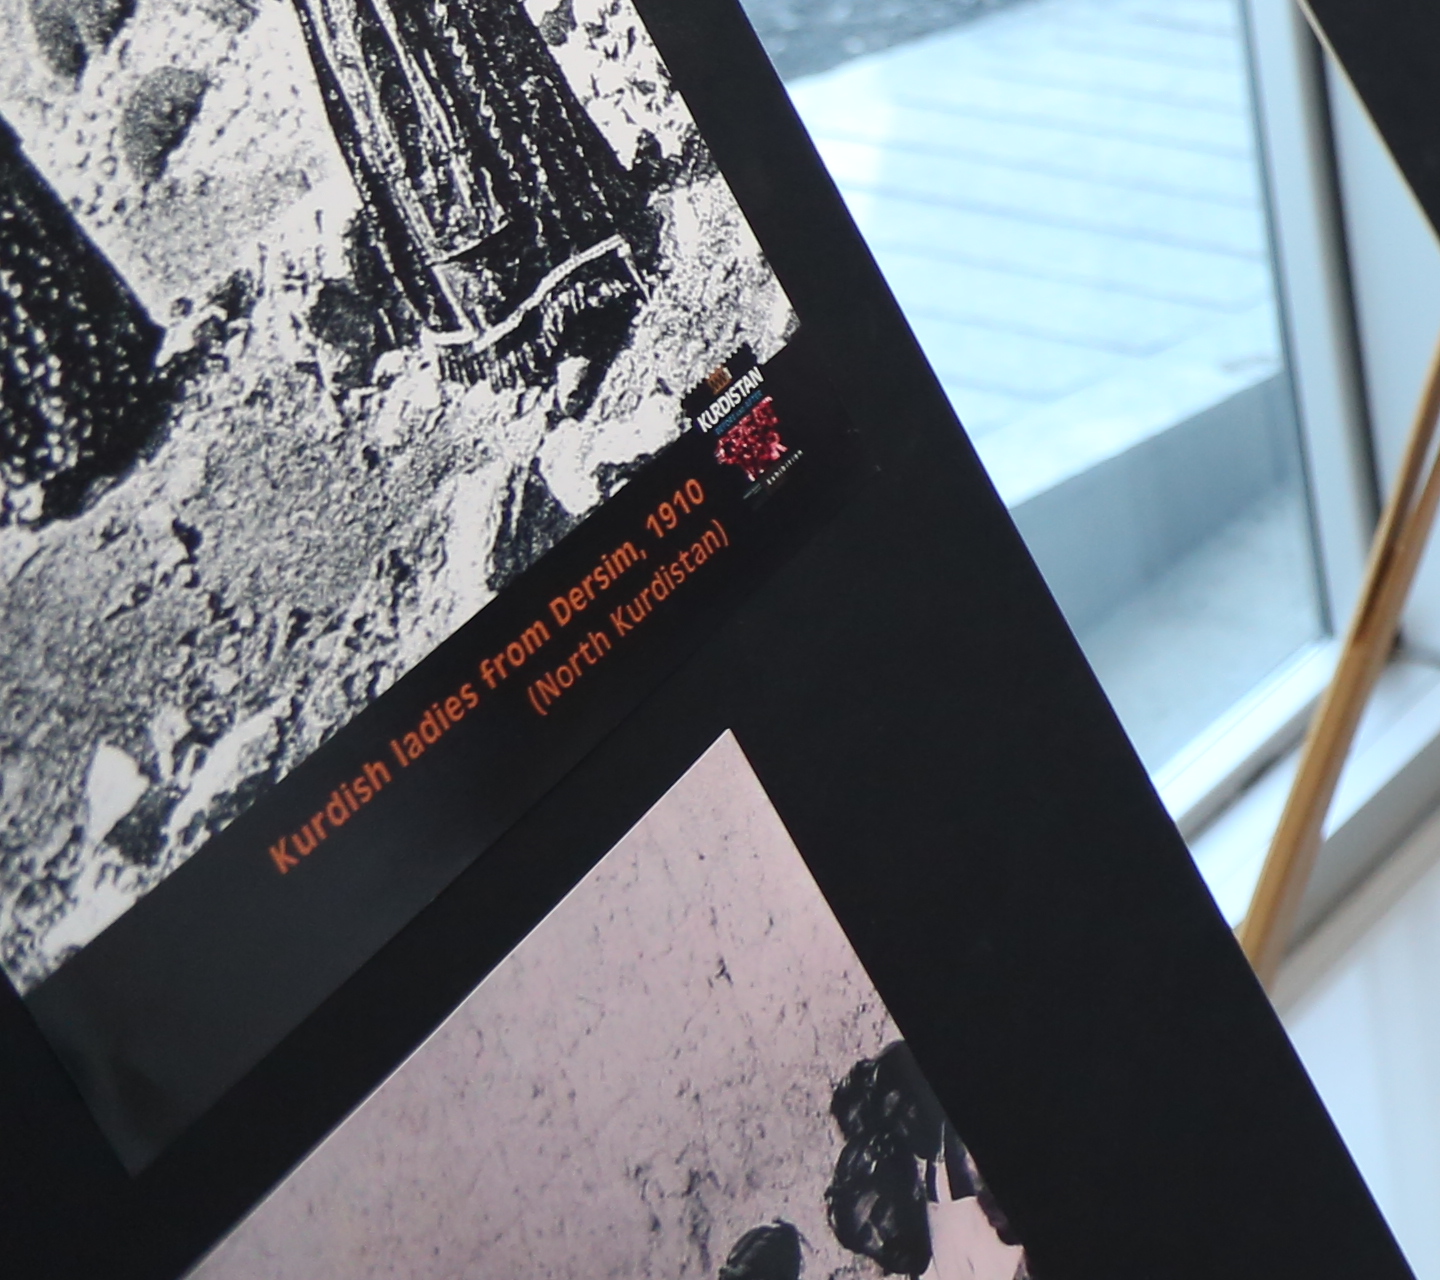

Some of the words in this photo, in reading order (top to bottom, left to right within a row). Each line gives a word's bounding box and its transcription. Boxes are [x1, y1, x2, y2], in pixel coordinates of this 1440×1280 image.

[696, 365, 765, 433] KURDISTAN
[268, 758, 393, 875] Kurdish
[389, 682, 480, 768] ladies
[479, 619, 552, 690] from
[548, 540, 648, 628] Dersim,
[645, 477, 706, 539] 1910
[526, 630, 612, 717] (North
[609, 517, 730, 637] Kurdistan)
